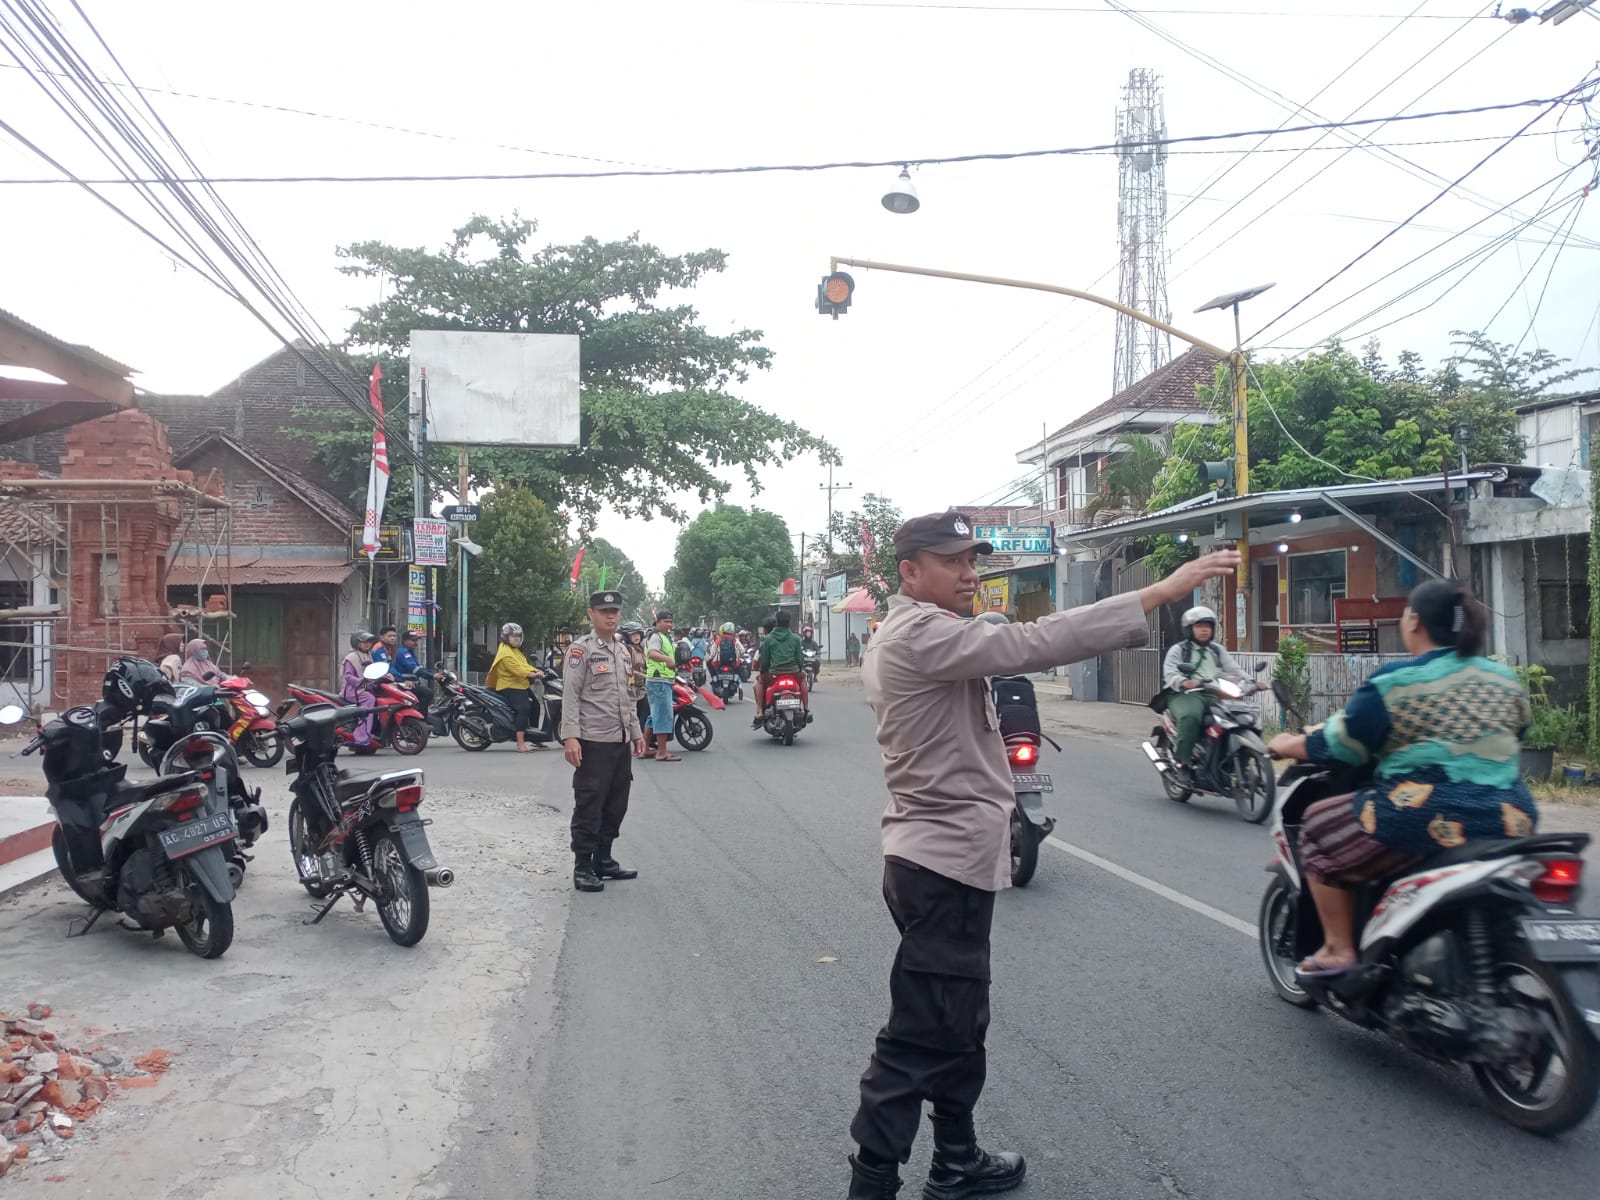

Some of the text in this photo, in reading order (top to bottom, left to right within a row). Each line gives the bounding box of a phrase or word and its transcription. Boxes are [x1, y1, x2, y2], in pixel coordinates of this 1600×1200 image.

[986, 539, 1048, 552] ARFUM
[164, 832, 180, 847] AG
[212, 816, 228, 829] US
